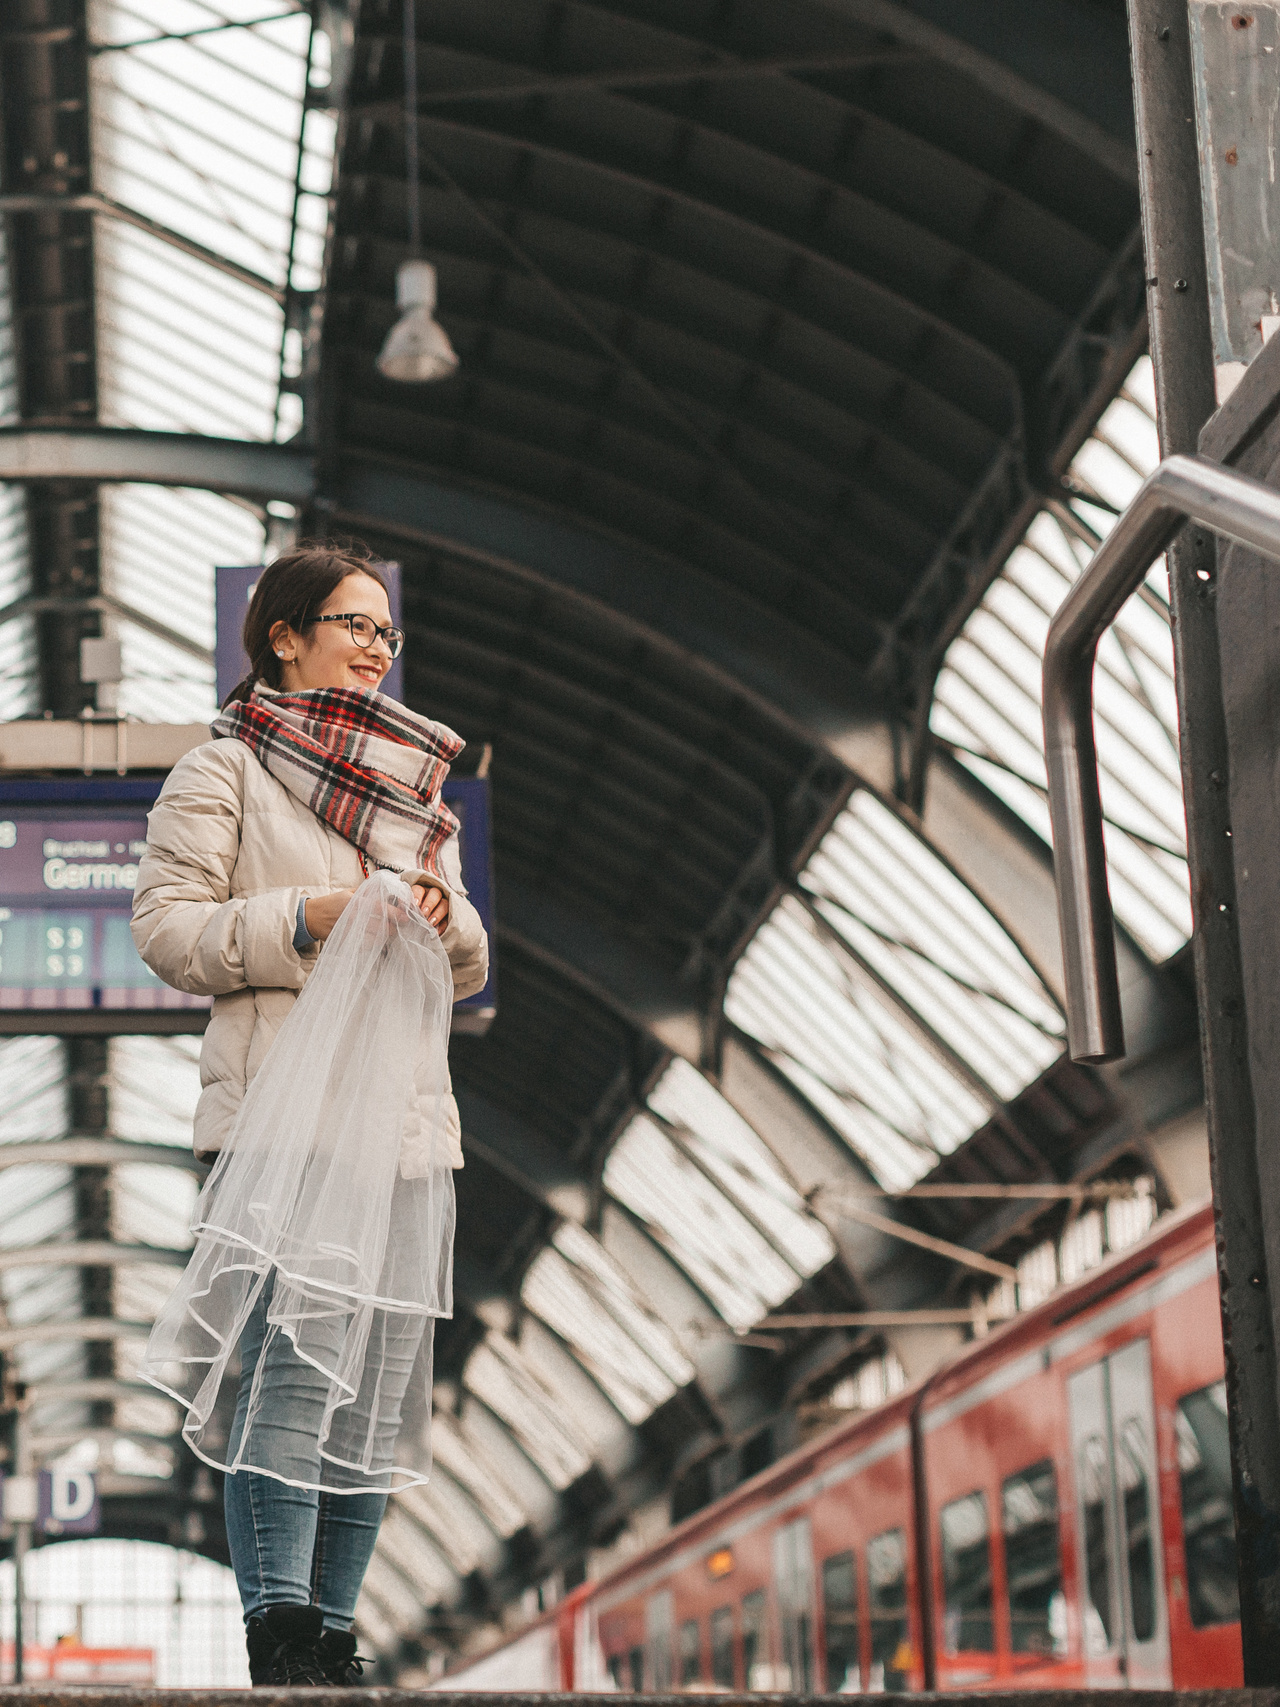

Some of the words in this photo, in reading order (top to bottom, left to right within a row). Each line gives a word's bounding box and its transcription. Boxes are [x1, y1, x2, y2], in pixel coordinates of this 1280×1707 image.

[46, 927, 65, 950] S
[67, 927, 84, 950] 3
[46, 954, 65, 977] S
[67, 954, 84, 977] 3
[51, 1471, 95, 1521] D
